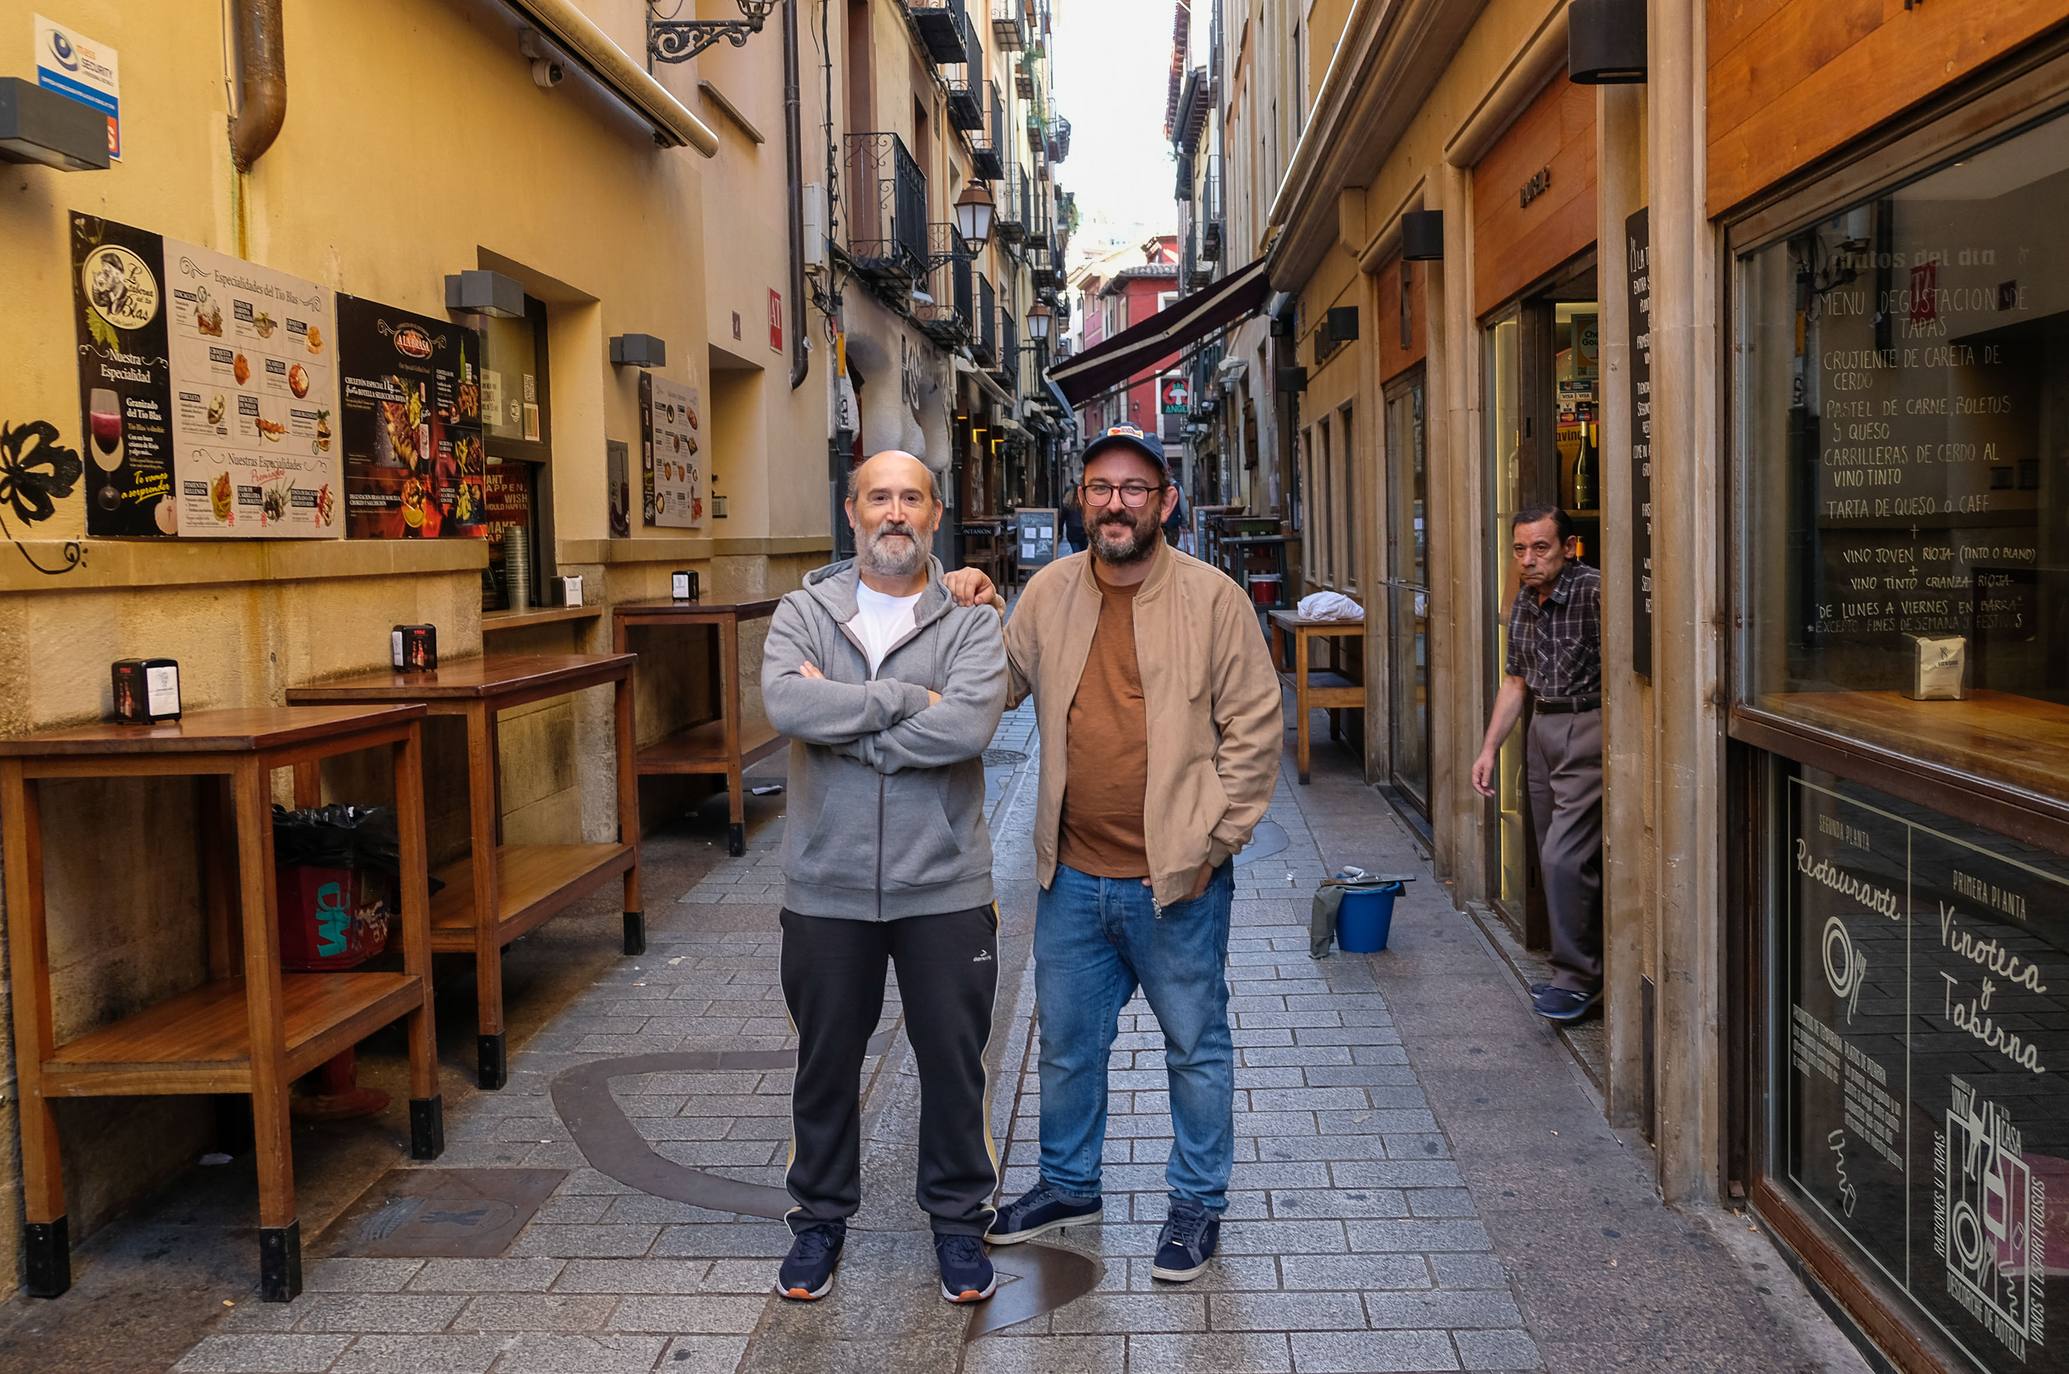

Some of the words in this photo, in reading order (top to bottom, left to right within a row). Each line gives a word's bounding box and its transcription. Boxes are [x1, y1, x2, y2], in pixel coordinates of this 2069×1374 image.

[1914, 248, 1951, 268] del
[214, 269, 264, 295] Especialidades
[264, 283, 274, 297] del
[286, 290, 299, 304] Blas
[122, 294, 149, 321] Blas
[770, 296, 782, 329] AT
[1820, 290, 1866, 316] MENU
[1880, 286, 1999, 314] DEGUSTACION
[2009, 286, 2030, 311] DE
[1900, 316, 1948, 340] TAPAS
[109, 348, 142, 366] Nuestra
[1823, 349, 1898, 371] CRUJIENTE
[1903, 348, 1920, 369] DE
[1924, 345, 1976, 368] CARETA
[1984, 344, 2002, 365] DE
[100, 363, 152, 384] Especialidad
[1833, 372, 1873, 392] CERDO
[126, 397, 159, 411] Granizado
[126, 408, 139, 418] del
[149, 410, 163, 421] Blas
[1826, 399, 1873, 420] PASTEL
[1882, 399, 1898, 418] DE
[1955, 395, 2014, 416] BOLETUS
[1848, 422, 1890, 441] QUESO
[227, 451, 259, 467] Nuestras
[259, 455, 303, 474] Especialidades
[1823, 445, 1910, 467] CARRILLERAS
[1916, 444, 1934, 464] DE
[1937, 443, 1977, 464] CERDO
[1983, 442, 2001, 462] AL
[133, 470, 144, 485] Te
[144, 472, 169, 484] vamos
[485, 474, 504, 485] ANT
[486, 484, 528, 493] APPEN.
[1833, 469, 1864, 488] VINO
[1867, 468, 1902, 487] TINTO
[121, 490, 128, 500] a
[128, 480, 171, 500] sorprender
[504, 494, 529, 504] WISH
[1826, 499, 1870, 521] TARTA
[1874, 497, 1891, 519] DE
[1894, 496, 1936, 517] QUESO
[1843, 547, 1872, 564] VINO
[1875, 546, 1915, 564] JOVEN
[1922, 546, 1955, 561] RIOJA
[1959, 545, 1989, 565] (TINTO
[1991, 546, 2000, 560] O
[1850, 576, 1877, 592] VINO
[1883, 576, 1918, 590] TINTO
[1925, 575, 1973, 589] CRIANZA
[1977, 573, 2015, 588] RIOJA
[1841, 601, 1880, 620] LUNES
[1885, 603, 1895, 615] A
[1900, 599, 1949, 616] VIERNES
[1958, 600, 1974, 613] EN
[1866, 617, 1895, 633] FINES
[1899, 616, 1913, 632] DE
[1915, 615, 1958, 631] SEMANA
[1818, 813, 1845, 842] SEGUNDA
[1845, 824, 1871, 852] PLANTA
[1796, 838, 1901, 921] Restaurante
[1952, 868, 1989, 905] PRIMERA
[1990, 884, 2027, 921] PLANTA
[1939, 900, 2047, 994] Vinoteca
[1981, 975, 1996, 1012] y
[1939, 970, 2046, 1074] Taberna
[2001, 1118, 2023, 1160] CASA
[1933, 1130, 1946, 1176] TAPAS
[1933, 1189, 1946, 1259] RACIONES
[2030, 1175, 2046, 1286] ESPIRITUOSOS
[2030, 1296, 2046, 1347] VINOS
